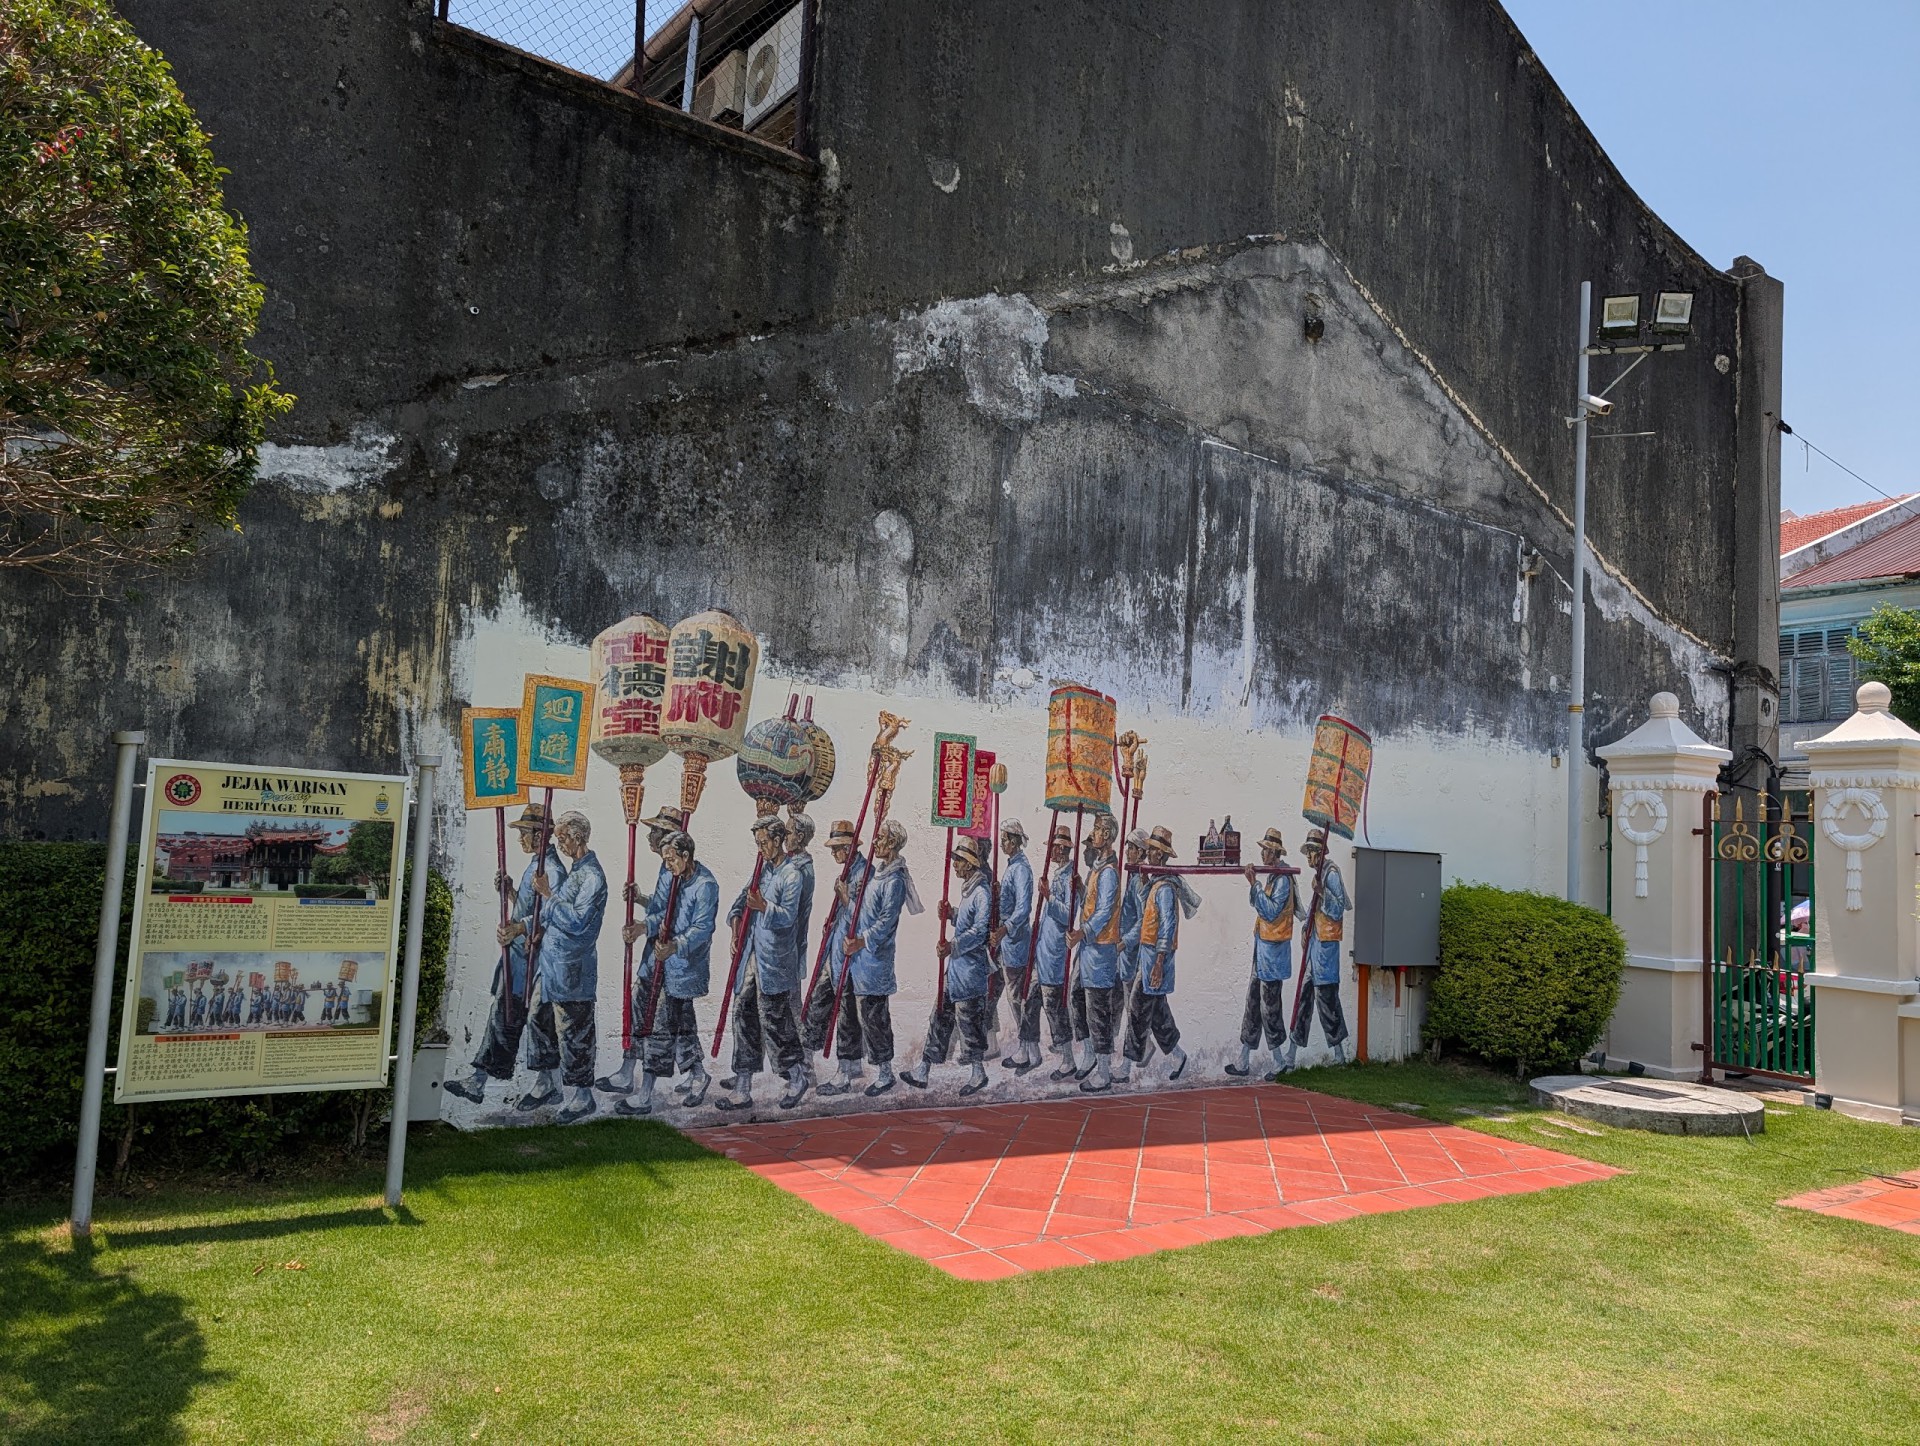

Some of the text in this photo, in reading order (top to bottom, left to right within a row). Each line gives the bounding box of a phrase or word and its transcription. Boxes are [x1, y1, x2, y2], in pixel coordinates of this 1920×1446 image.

[221, 775, 273, 792] JEJAK
[276, 778, 348, 796] WARISAN
[260, 789, 312, 804] Penang
[223, 800, 344, 816] HERITAGE TRAIL
